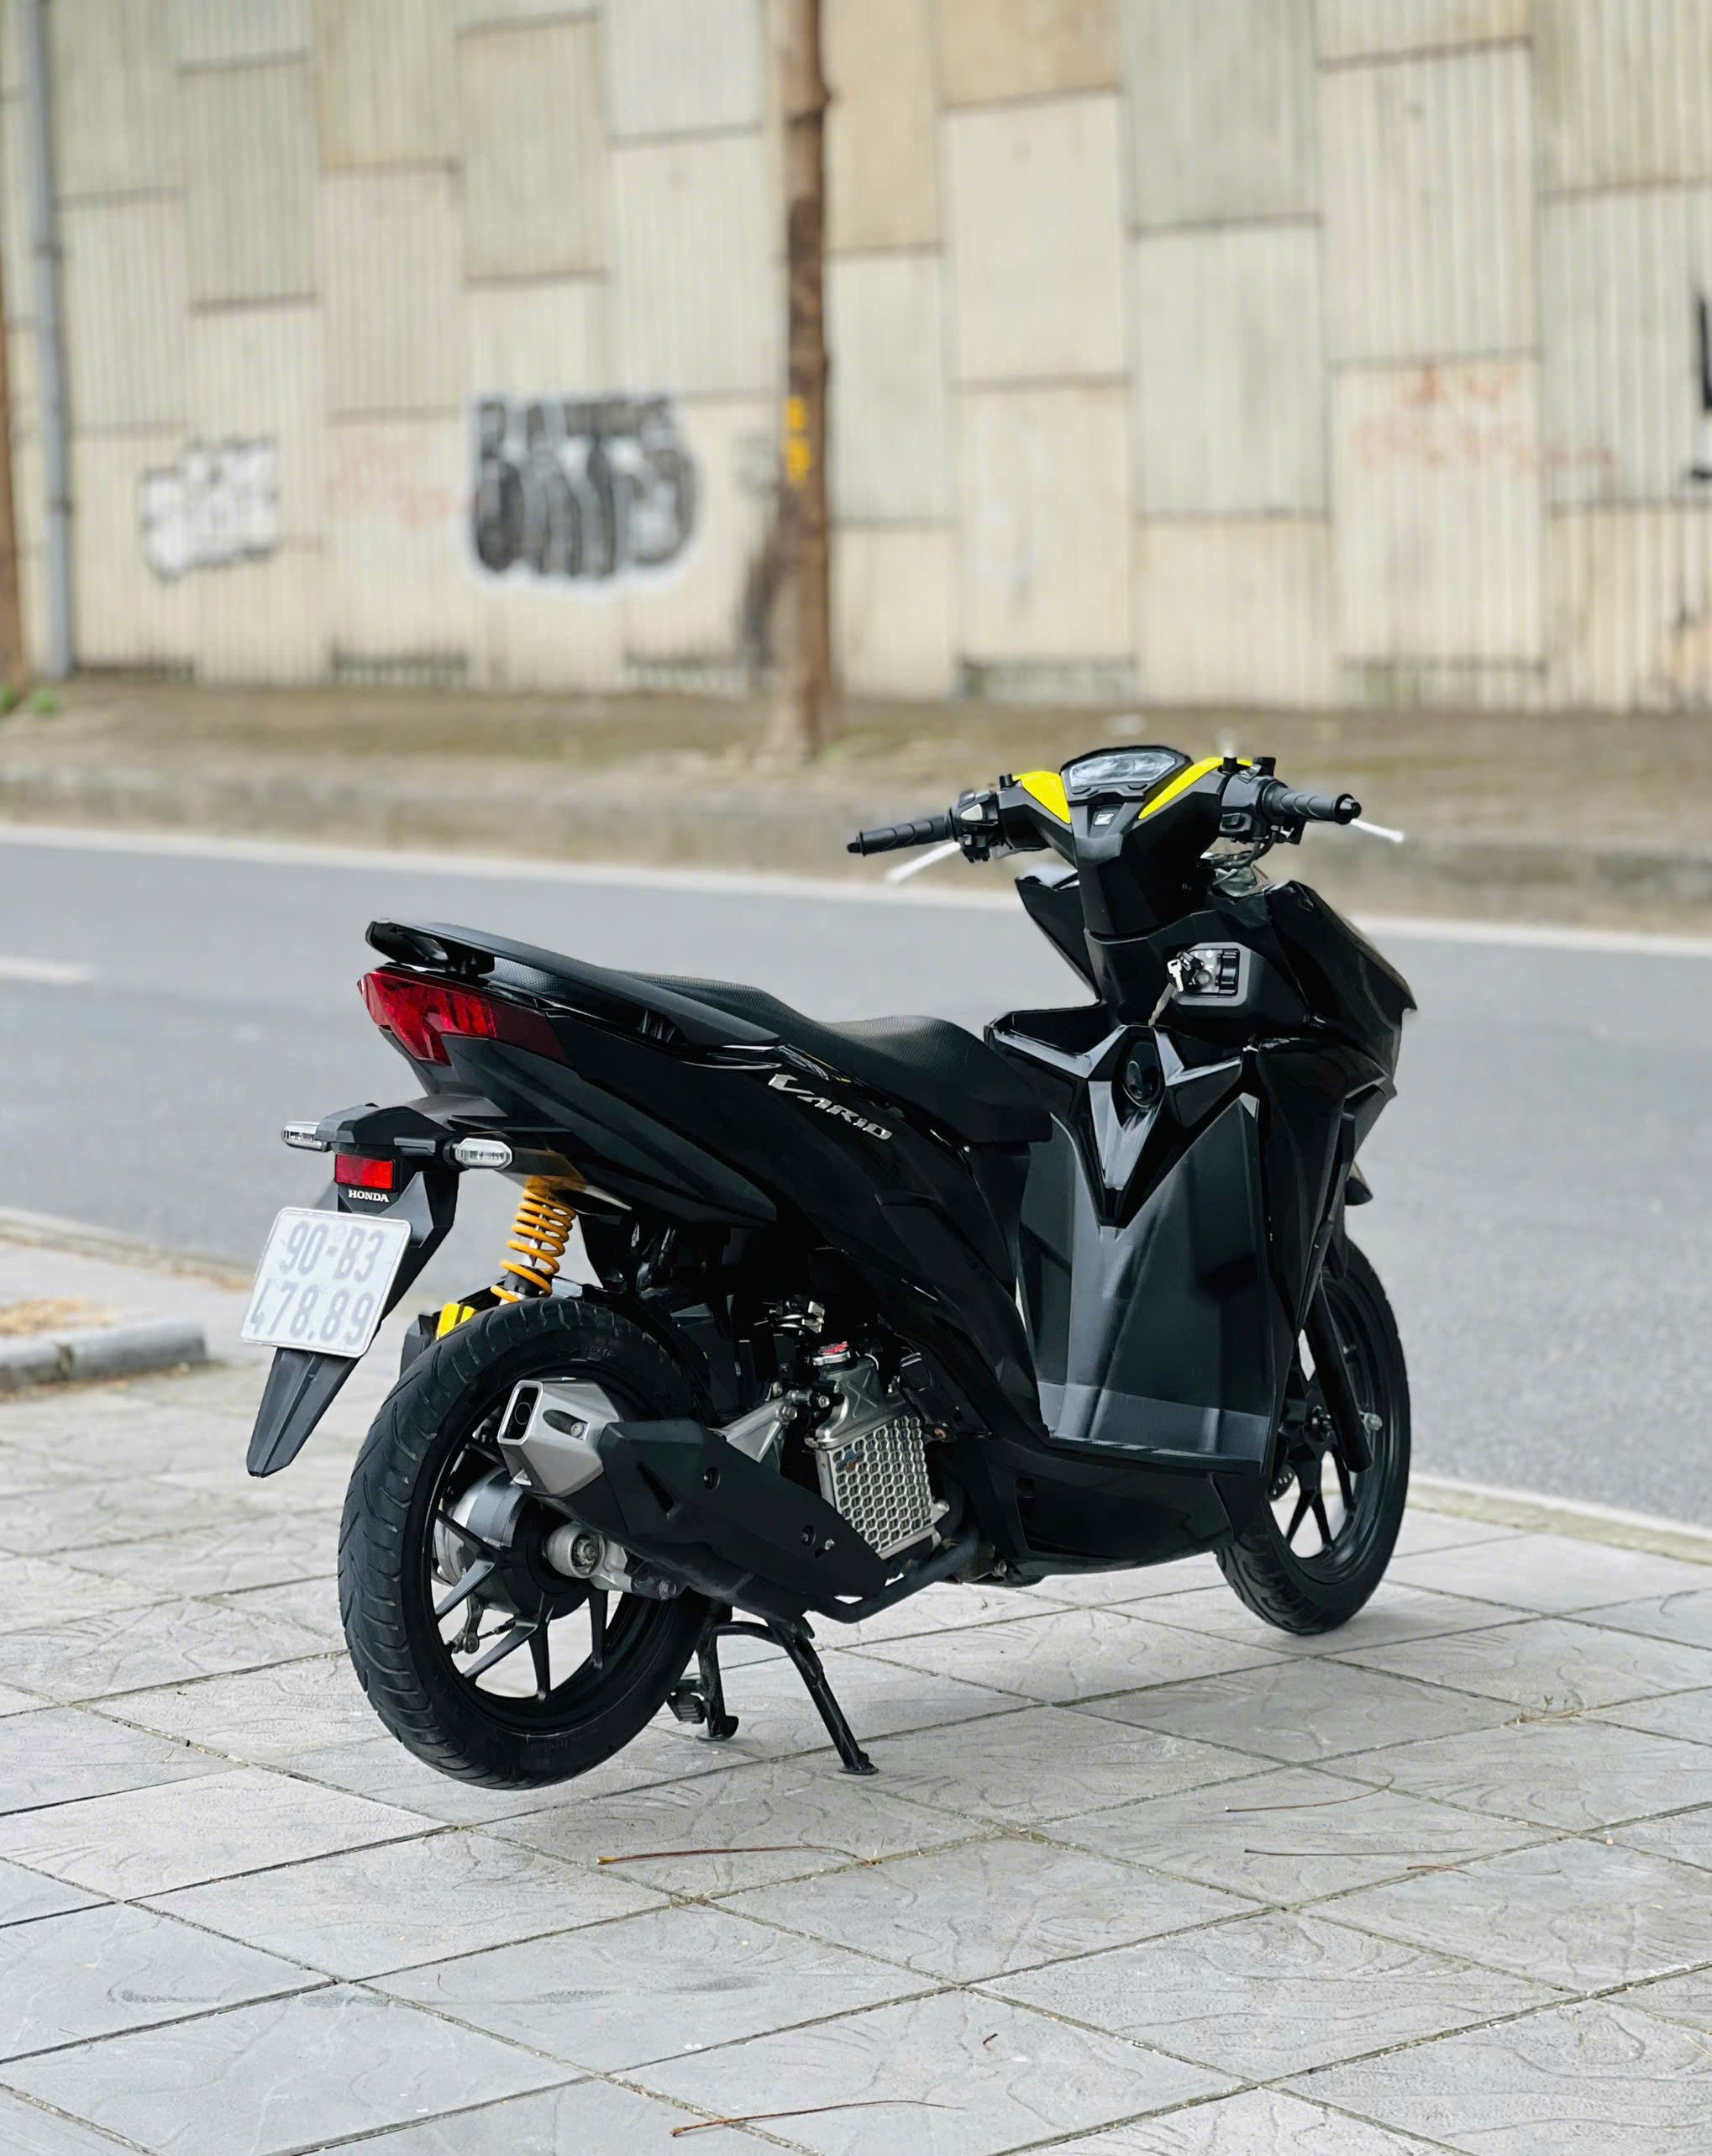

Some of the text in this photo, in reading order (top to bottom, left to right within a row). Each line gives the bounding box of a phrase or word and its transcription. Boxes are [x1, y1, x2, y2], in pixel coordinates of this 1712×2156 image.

[769, 1074, 893, 1140] VARIO
[349, 1190, 389, 1202] HONDA
[279, 1221, 383, 1282] 90-B3
[251, 1280, 375, 1344] 478.89
